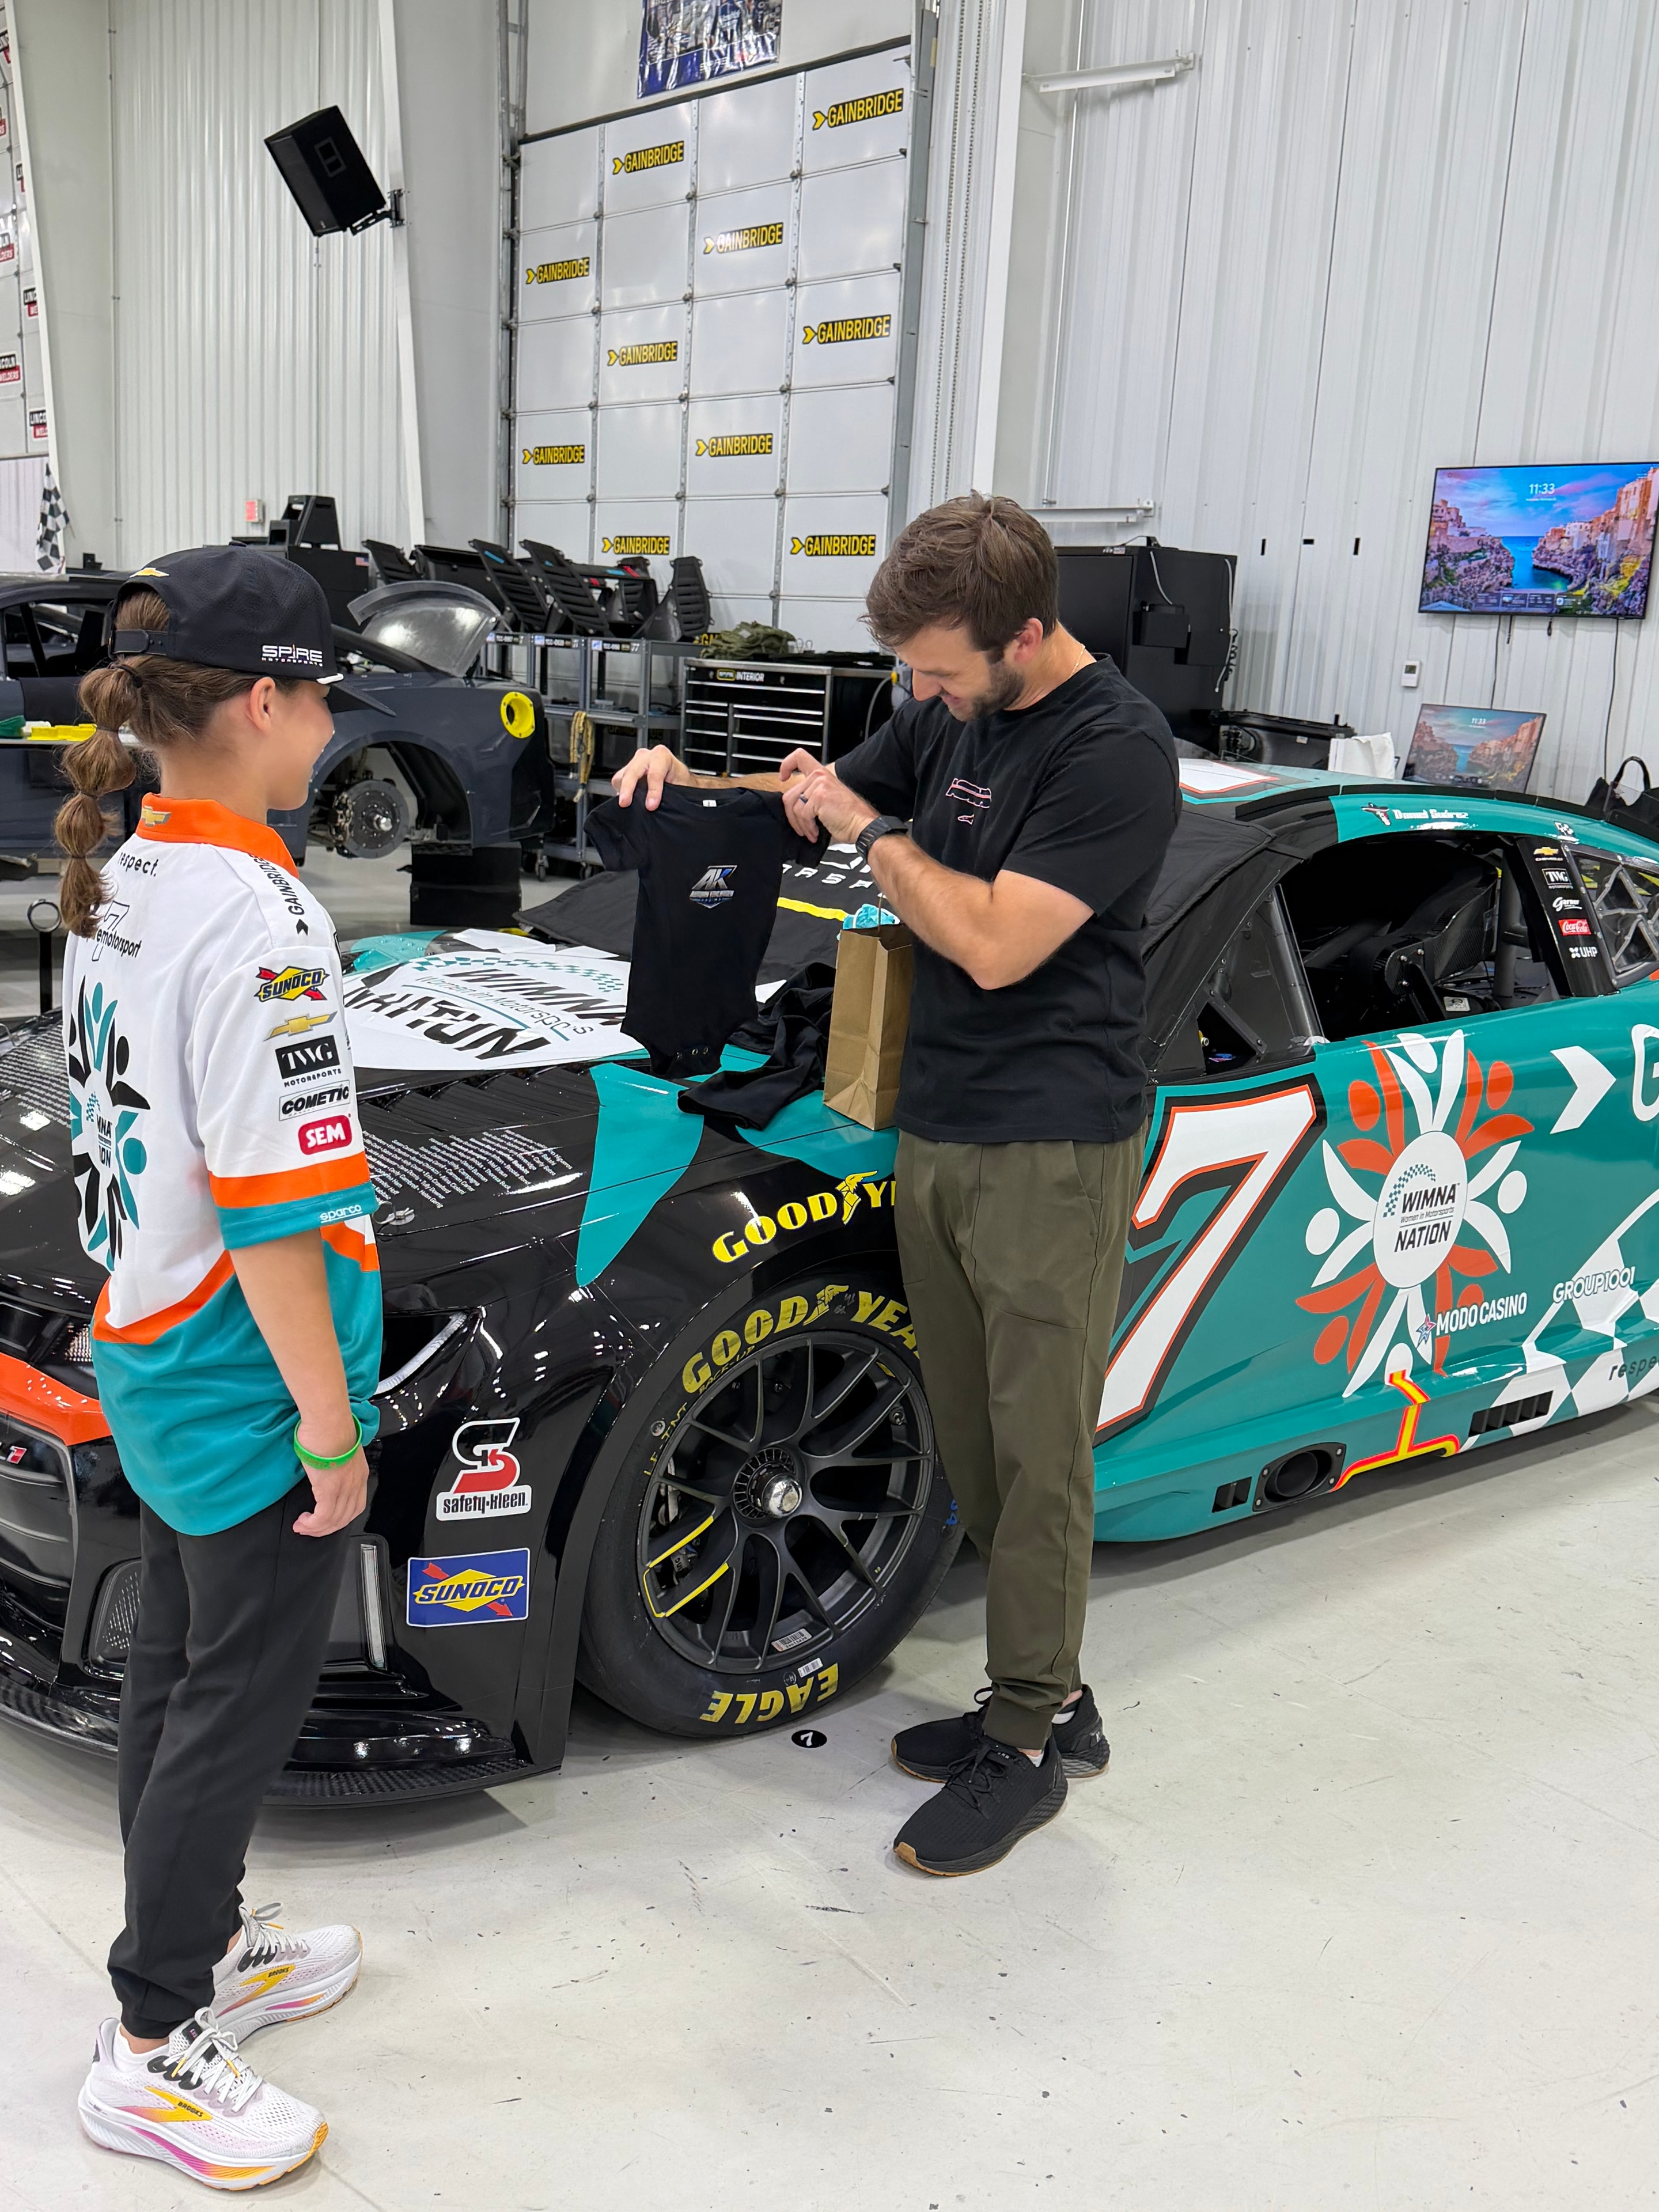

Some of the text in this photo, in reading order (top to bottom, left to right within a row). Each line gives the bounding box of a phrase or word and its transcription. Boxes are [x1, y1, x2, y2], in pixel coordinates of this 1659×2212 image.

[827, 90, 902, 127] GAINBRIDGE
[624, 142, 683, 172] GAINBRIDGE
[717, 224, 783, 252] GAINBRIDGE
[537, 258, 589, 283] GAINBRIDGE
[817, 315, 890, 343] GAINBRIDGE
[619, 342, 677, 365] GAINBRIDGE
[533, 445, 585, 464] GAINBRIDGE
[709, 434, 772, 456] GAINBRIDGE
[1529, 483, 1555, 495] 11:33
[613, 537, 669, 555] GAINBRIDGE
[805, 535, 876, 555] GAINBRIDGE
[262, 645, 323, 662] SPIRE
[736, 671, 765, 682] INTERIOR
[247, 852, 305, 915] GAINBRIDG
[1546, 871, 1569, 882] TWG
[97, 929, 142, 959] emotorsport
[1579, 946, 1598, 957] UHP
[262, 971, 322, 997] SUNOCO
[282, 1043, 333, 1070] TWG
[284, 1068, 342, 1088] MOTORSPORTS
[282, 1085, 349, 1115] COMETIC
[305, 1120, 346, 1149] SEM
[1402, 1183, 1456, 1214] WIMNA
[319, 1203, 363, 1224] sparco
[1400, 1214, 1419, 1224] Women
[1425, 1206, 1455, 1218] Motorsports
[1394, 1219, 1452, 1253] NATION
[1096, 1084, 1317, 1433] 7
[1435, 1291, 1528, 1336] MODO CASINO
[1608, 1355, 1659, 1381] respe
[419, 1578, 522, 1603] SUNOCO
[699, 1662, 839, 1724] EAGLE
[800, 1732, 814, 1747] 7
[177, 2101, 204, 2118] BROOKS
